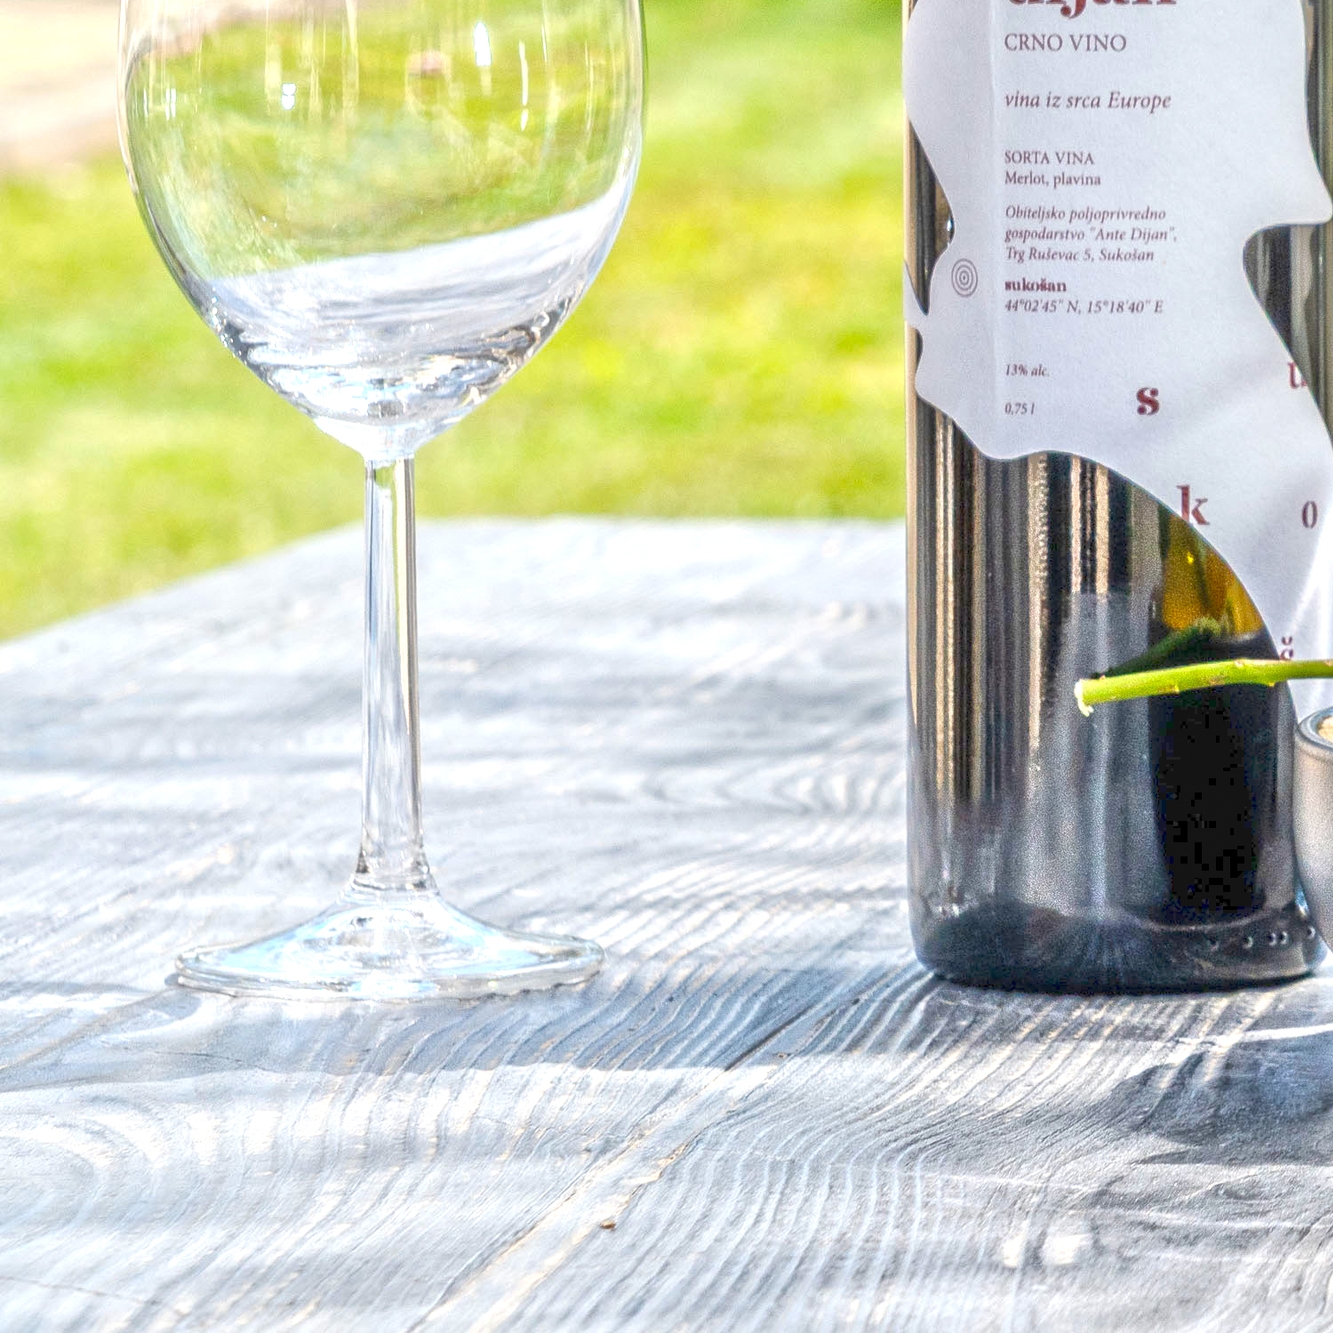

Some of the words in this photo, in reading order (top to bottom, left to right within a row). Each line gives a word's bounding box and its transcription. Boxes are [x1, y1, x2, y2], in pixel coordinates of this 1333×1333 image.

[1004, 33, 1063, 52] CRNO
[1069, 33, 1127, 52] VINO
[1004, 91, 1040, 109] vina
[1046, 91, 1061, 109] iz
[1066, 94, 1101, 109] srca
[1107, 91, 1172, 114] Europe
[1004, 150, 1050, 165] SORTA
[1055, 150, 1095, 165] VINA
[1004, 171, 1050, 188] Merlot,
[1053, 171, 1102, 190] plavina
[1005, 205, 1066, 224] Obiteljsko
[1069, 206, 1167, 225] poljoprivredno
[1005, 227, 1086, 244] gospodarstvo
[1090, 226, 1127, 241] "Ante
[1006, 247, 1027, 265] Trg
[1029, 245, 1082, 261] Ruševac
[1085, 248, 1095, 264] 5,
[1099, 246, 1155, 262] Sukošan
[1004, 278, 1067, 293] sukošan
[1066, 299, 1083, 316] N,
[1154, 299, 1164, 314] E
[1005, 363, 1029, 378] 13%
[1031, 363, 1050, 378] alc.
[1005, 401, 1029, 417] 0,75
[1136, 386, 1160, 416] s
[1177, 484, 1210, 526] k
